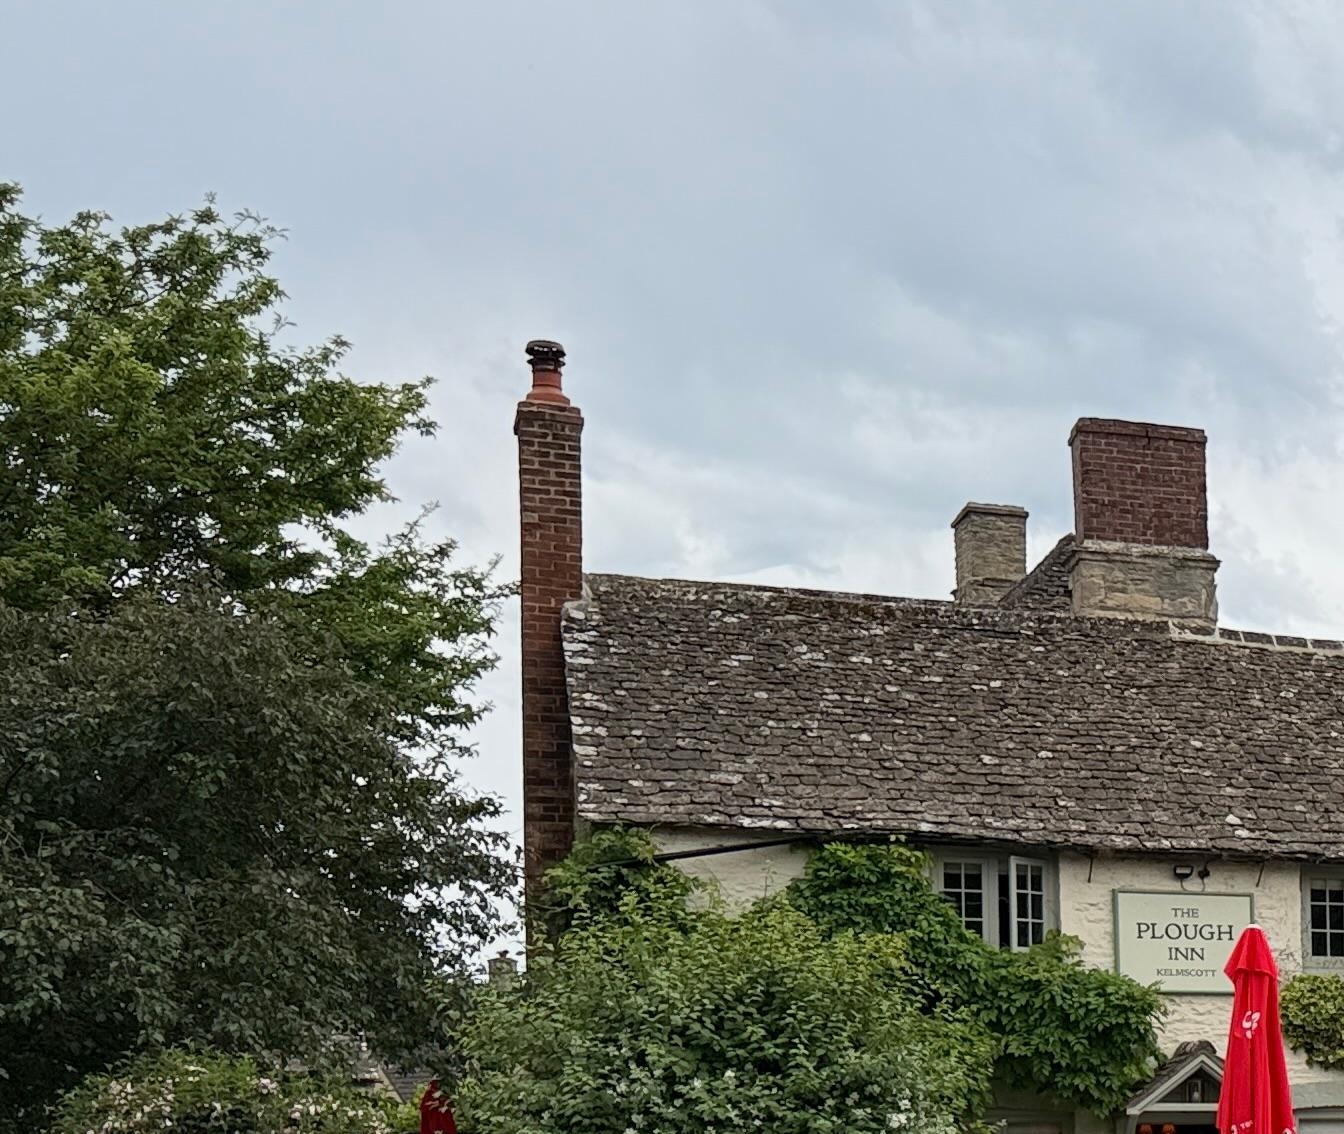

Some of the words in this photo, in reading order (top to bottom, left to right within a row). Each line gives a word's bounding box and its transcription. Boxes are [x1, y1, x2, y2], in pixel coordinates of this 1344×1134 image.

[1171, 908, 1199, 918] THE
[1136, 922, 1233, 941] PLOUGH
[1168, 947, 1204, 961] INN
[1156, 968, 1216, 977] KELMSCOTT
